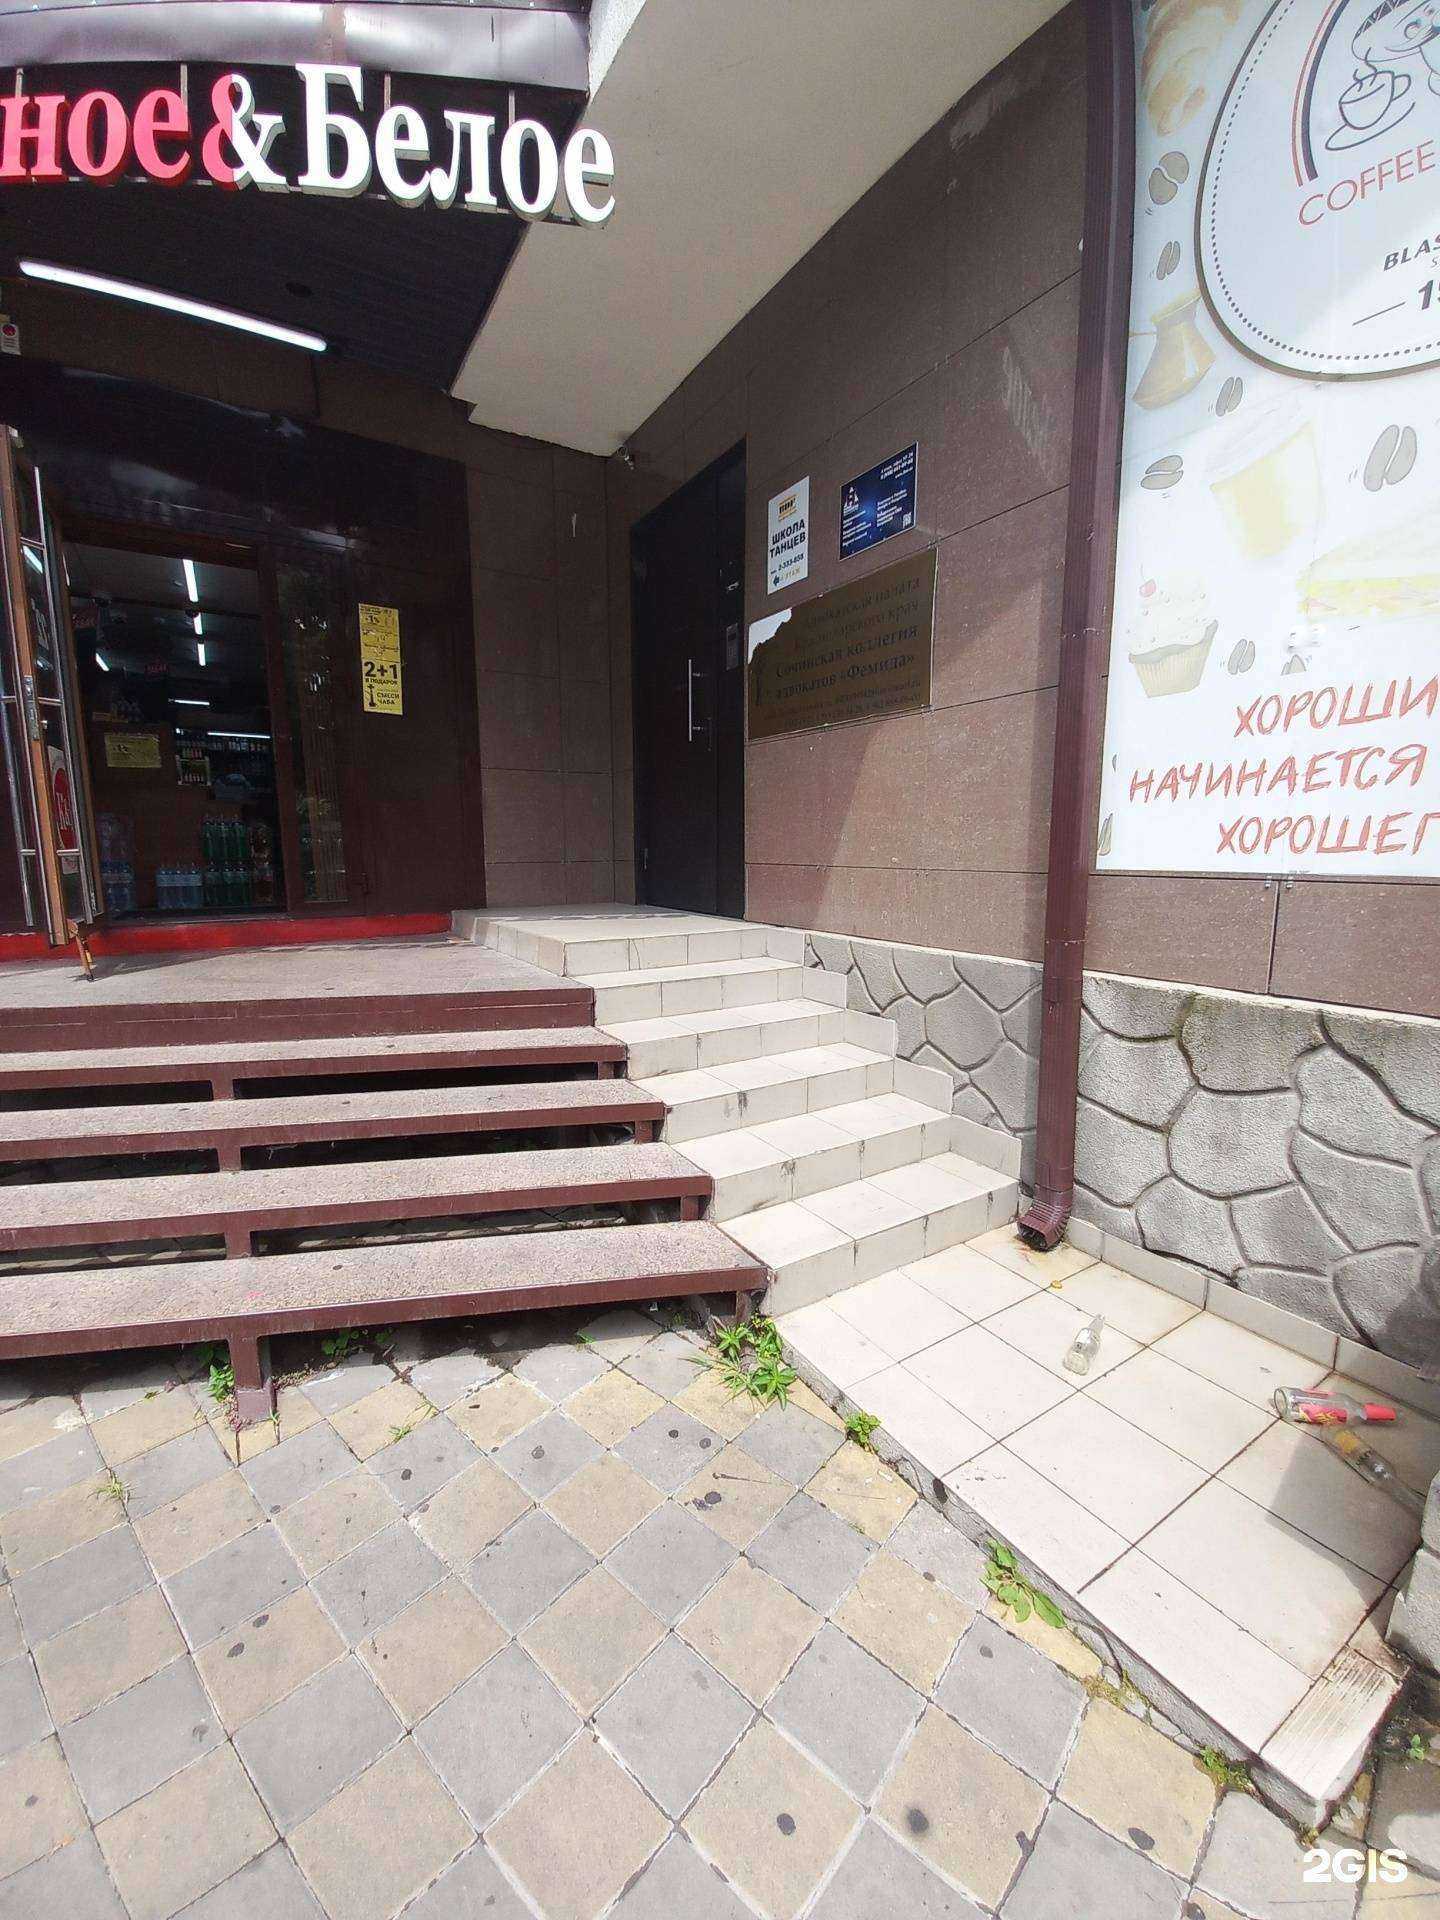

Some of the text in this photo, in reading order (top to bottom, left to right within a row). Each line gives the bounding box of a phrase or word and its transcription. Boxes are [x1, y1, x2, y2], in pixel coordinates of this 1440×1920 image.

[1299, 140, 1436, 226] COFFEE
[769, 532, 806, 558] ТАНЦЕВ
[772, 518, 805, 545] ШКОЛА
[363, 661, 398, 680] 2+1
[1234, 674, 1439, 737] ХОРОШИ
[1129, 743, 1428, 803] НАЧИНАЕТСЯ
[1216, 811, 1440, 856] ХОРОШЕГ
